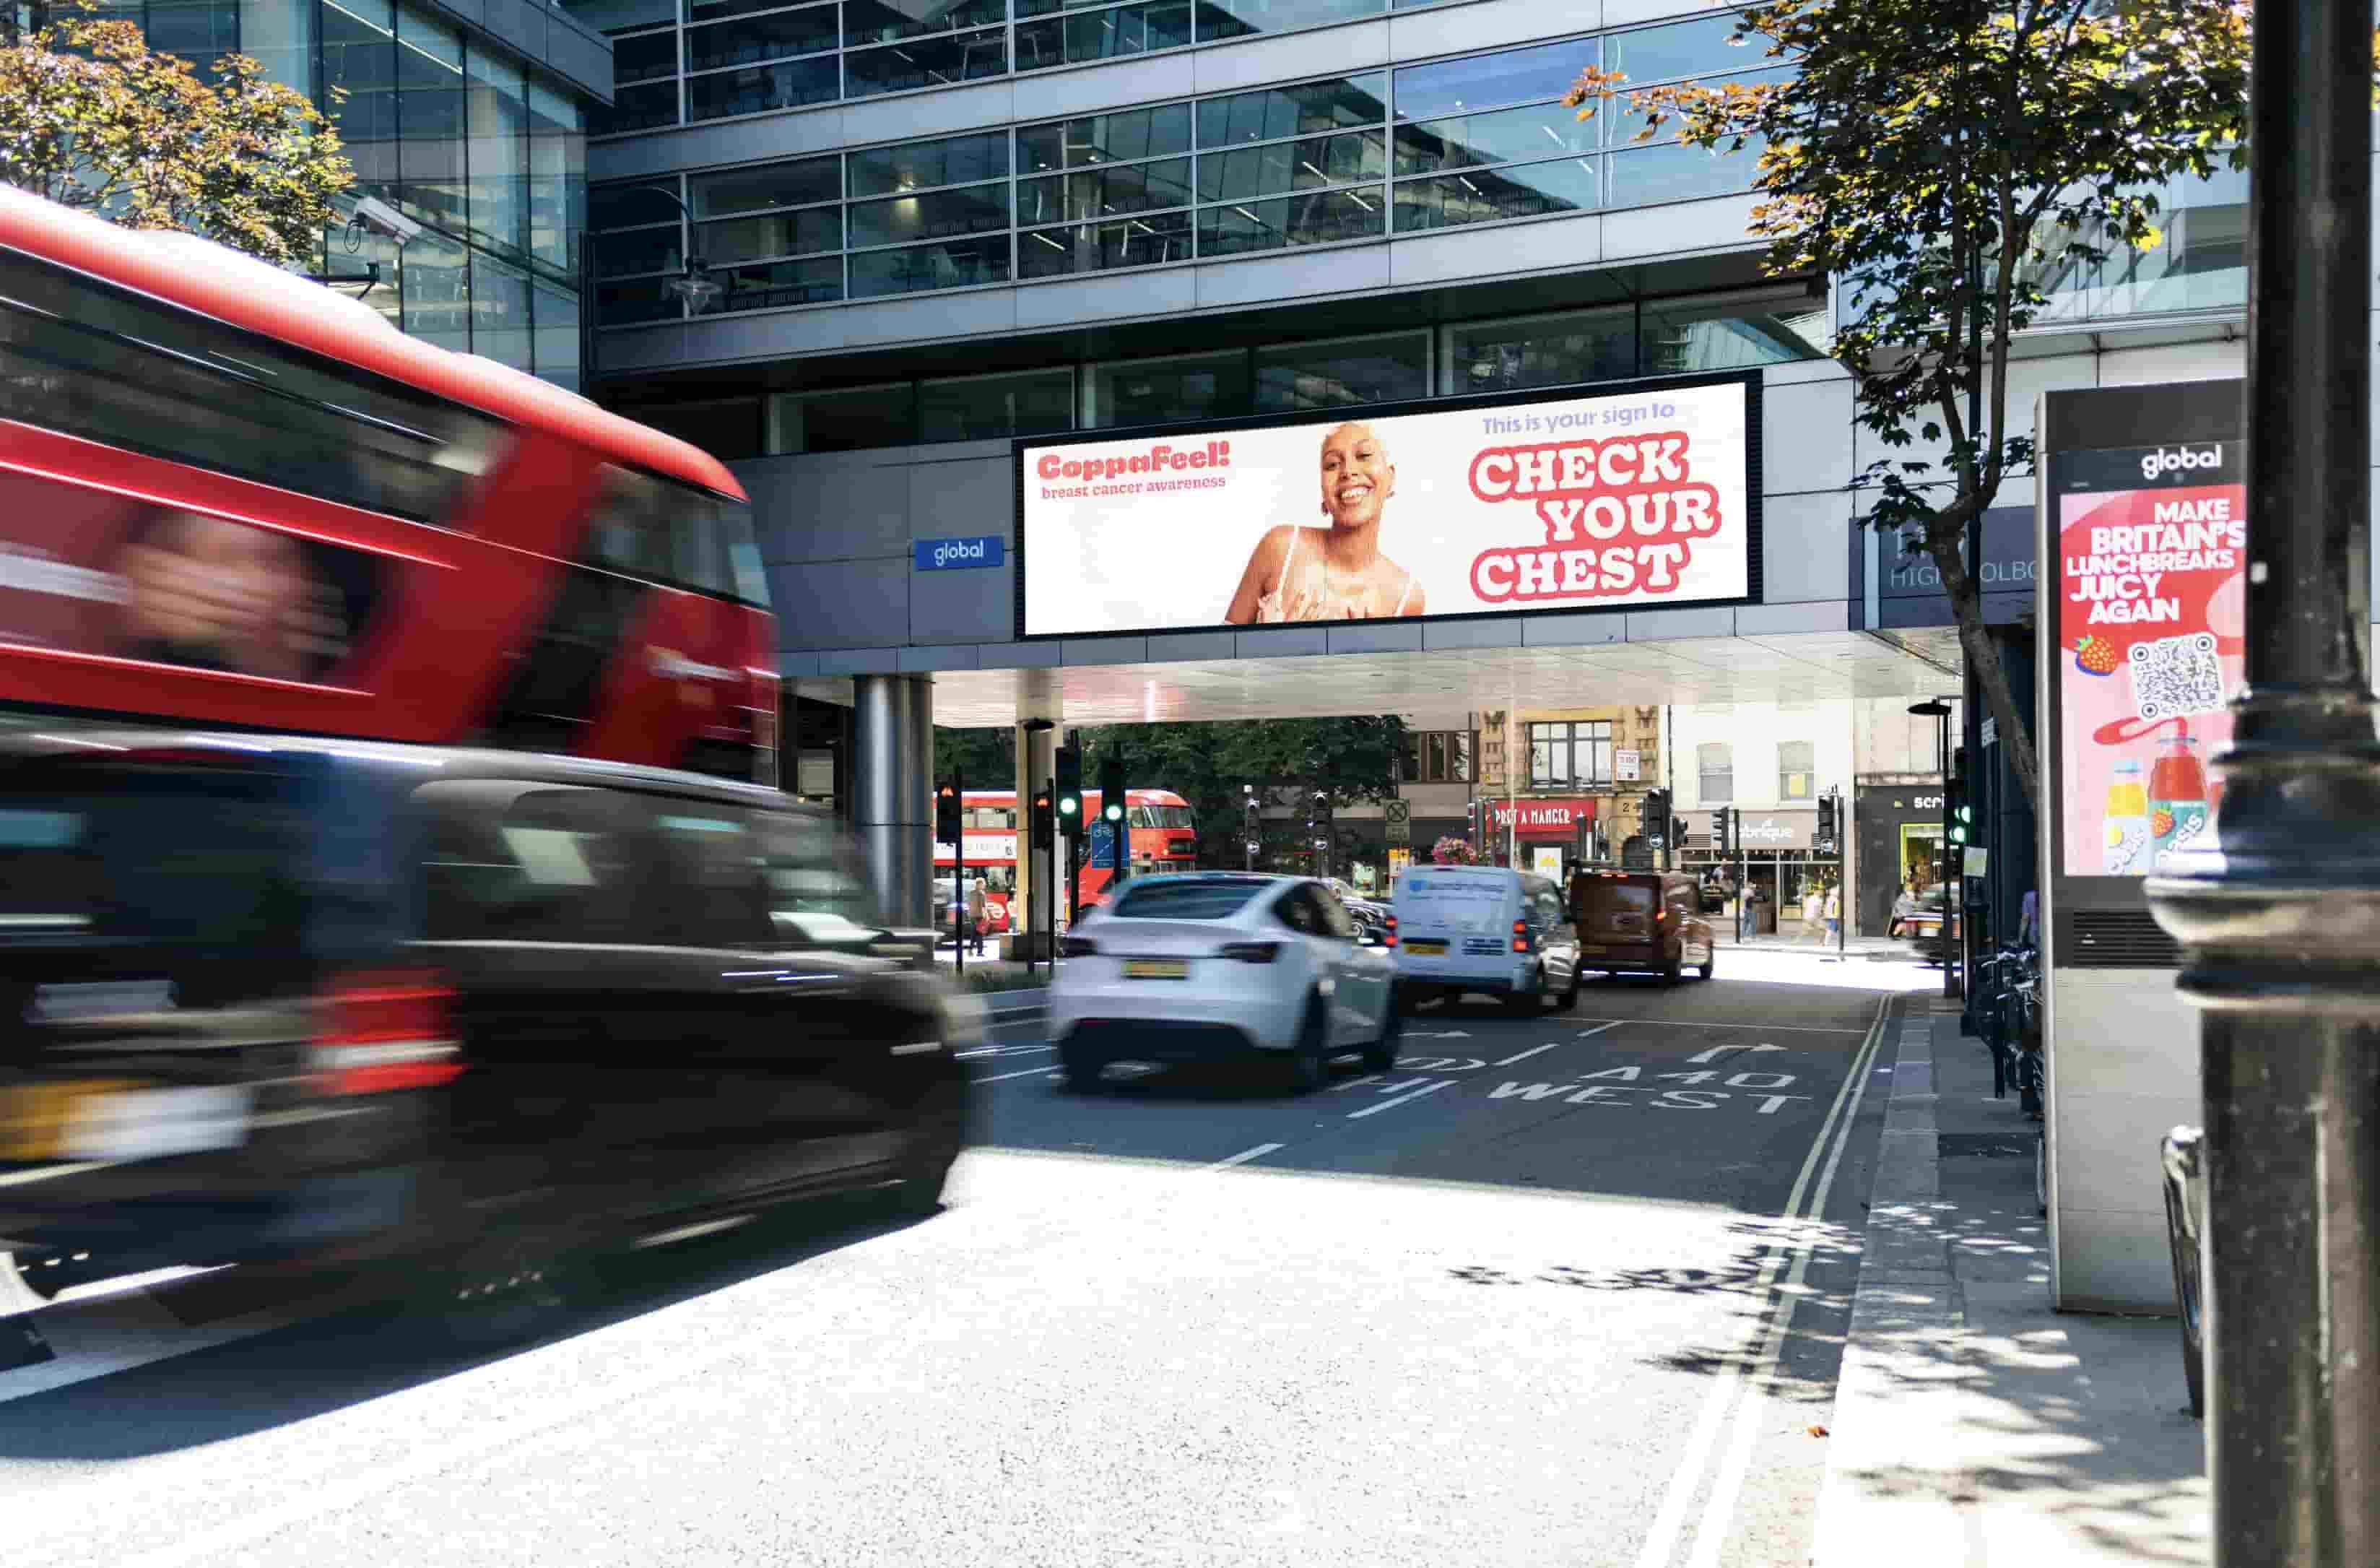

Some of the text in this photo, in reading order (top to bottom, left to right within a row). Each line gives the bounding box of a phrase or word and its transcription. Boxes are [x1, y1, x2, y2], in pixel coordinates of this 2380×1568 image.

[1482, 402, 1675, 434] This is your sign to
[1037, 440, 1230, 481] CoppaFeel!
[1475, 438, 1682, 495] CHECK
[2142, 443, 2223, 480] global
[1041, 477, 1226, 500] breast cancer awareness
[1545, 489, 1715, 542] YOUR
[2154, 498, 2230, 523] MAKE
[2091, 519, 2246, 555] BRITAIN'S
[934, 539, 984, 567] global
[2067, 549, 2236, 576] LUNCHBREAKS
[1477, 543, 1684, 596] CHEST
[1890, 566, 1940, 587] HIG
[2069, 573, 2162, 602] JUICY
[2088, 597, 2180, 624] AGAIN
[1521, 808, 1528, 825] A
[1486, 1080, 1812, 1114] WEST
